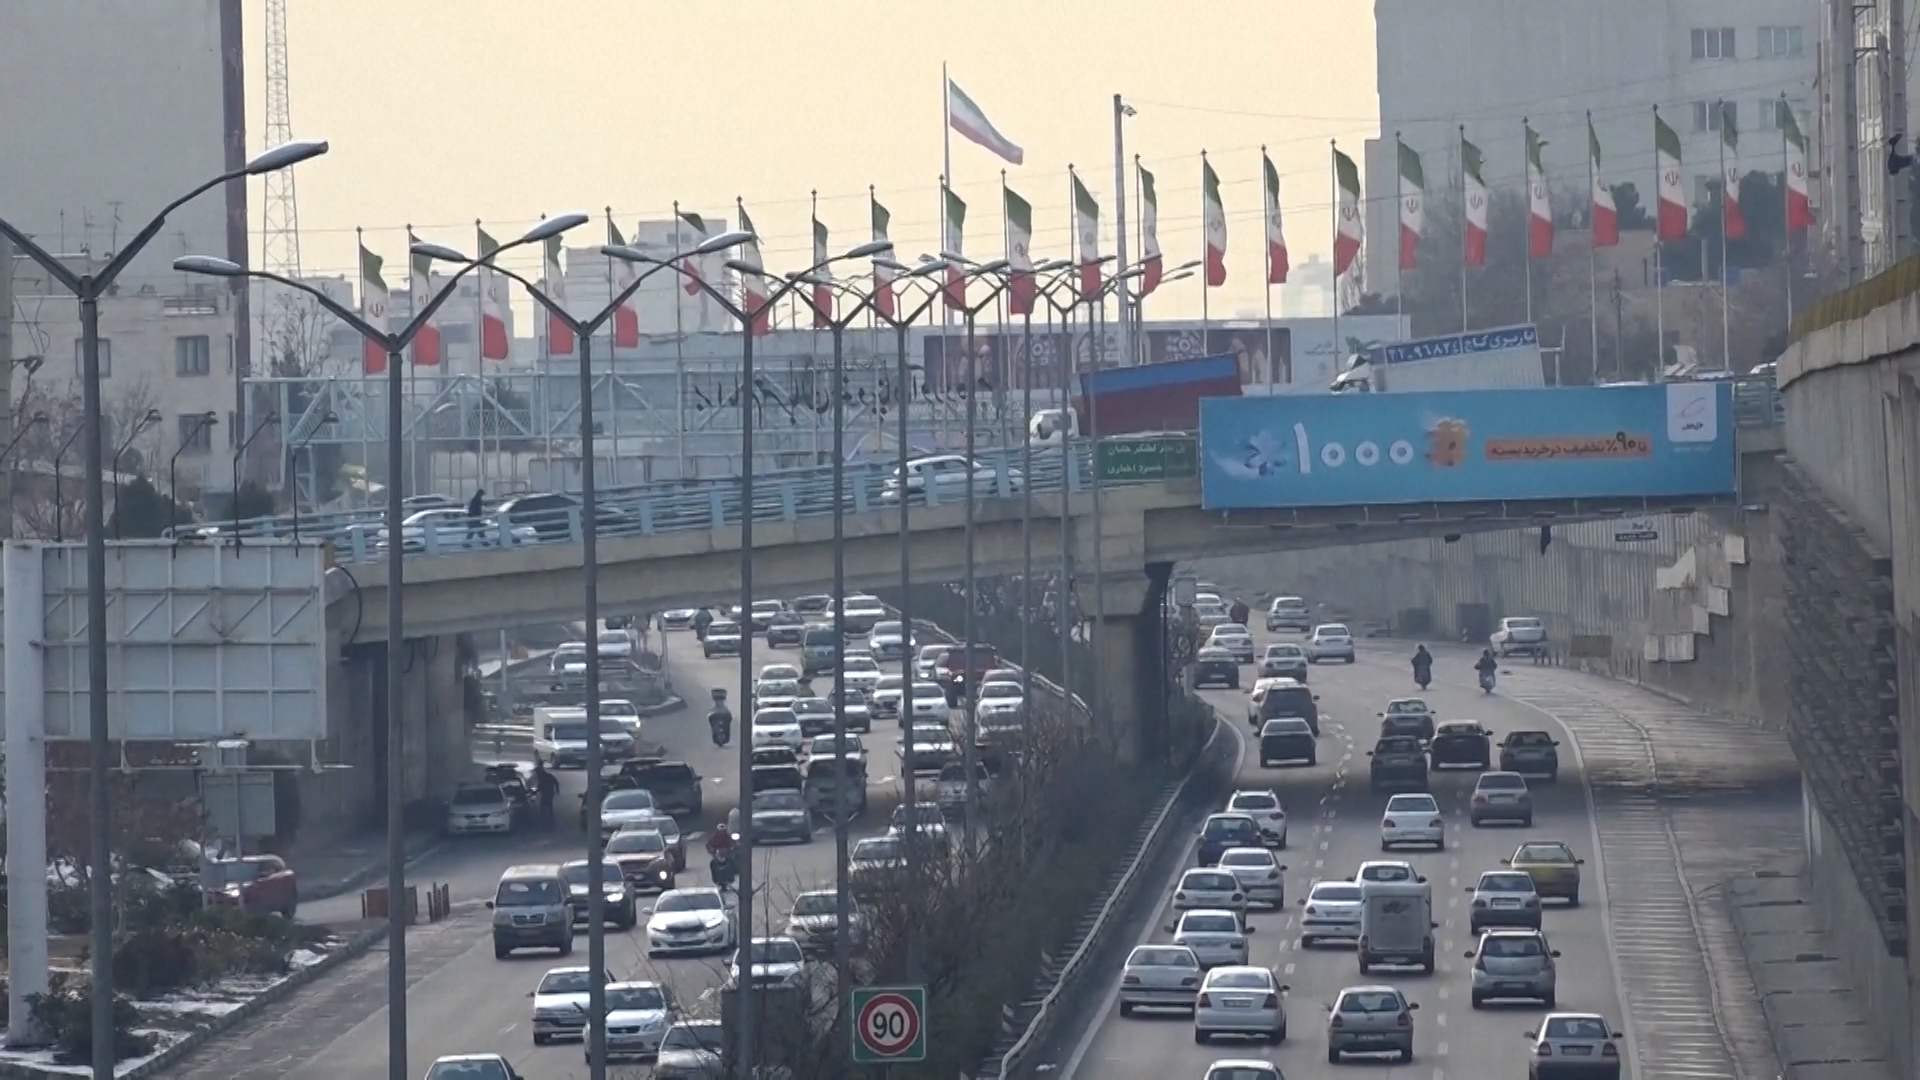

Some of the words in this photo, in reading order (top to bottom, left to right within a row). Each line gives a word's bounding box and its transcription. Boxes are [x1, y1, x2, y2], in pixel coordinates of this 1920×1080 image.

[1489, 330, 1535, 349] باربری
[1491, 446, 1522, 457] بسته
[1523, 444, 1549, 457] خرید
[1565, 441, 1605, 455] تخفیف
[873, 1011, 905, 1040] 90
